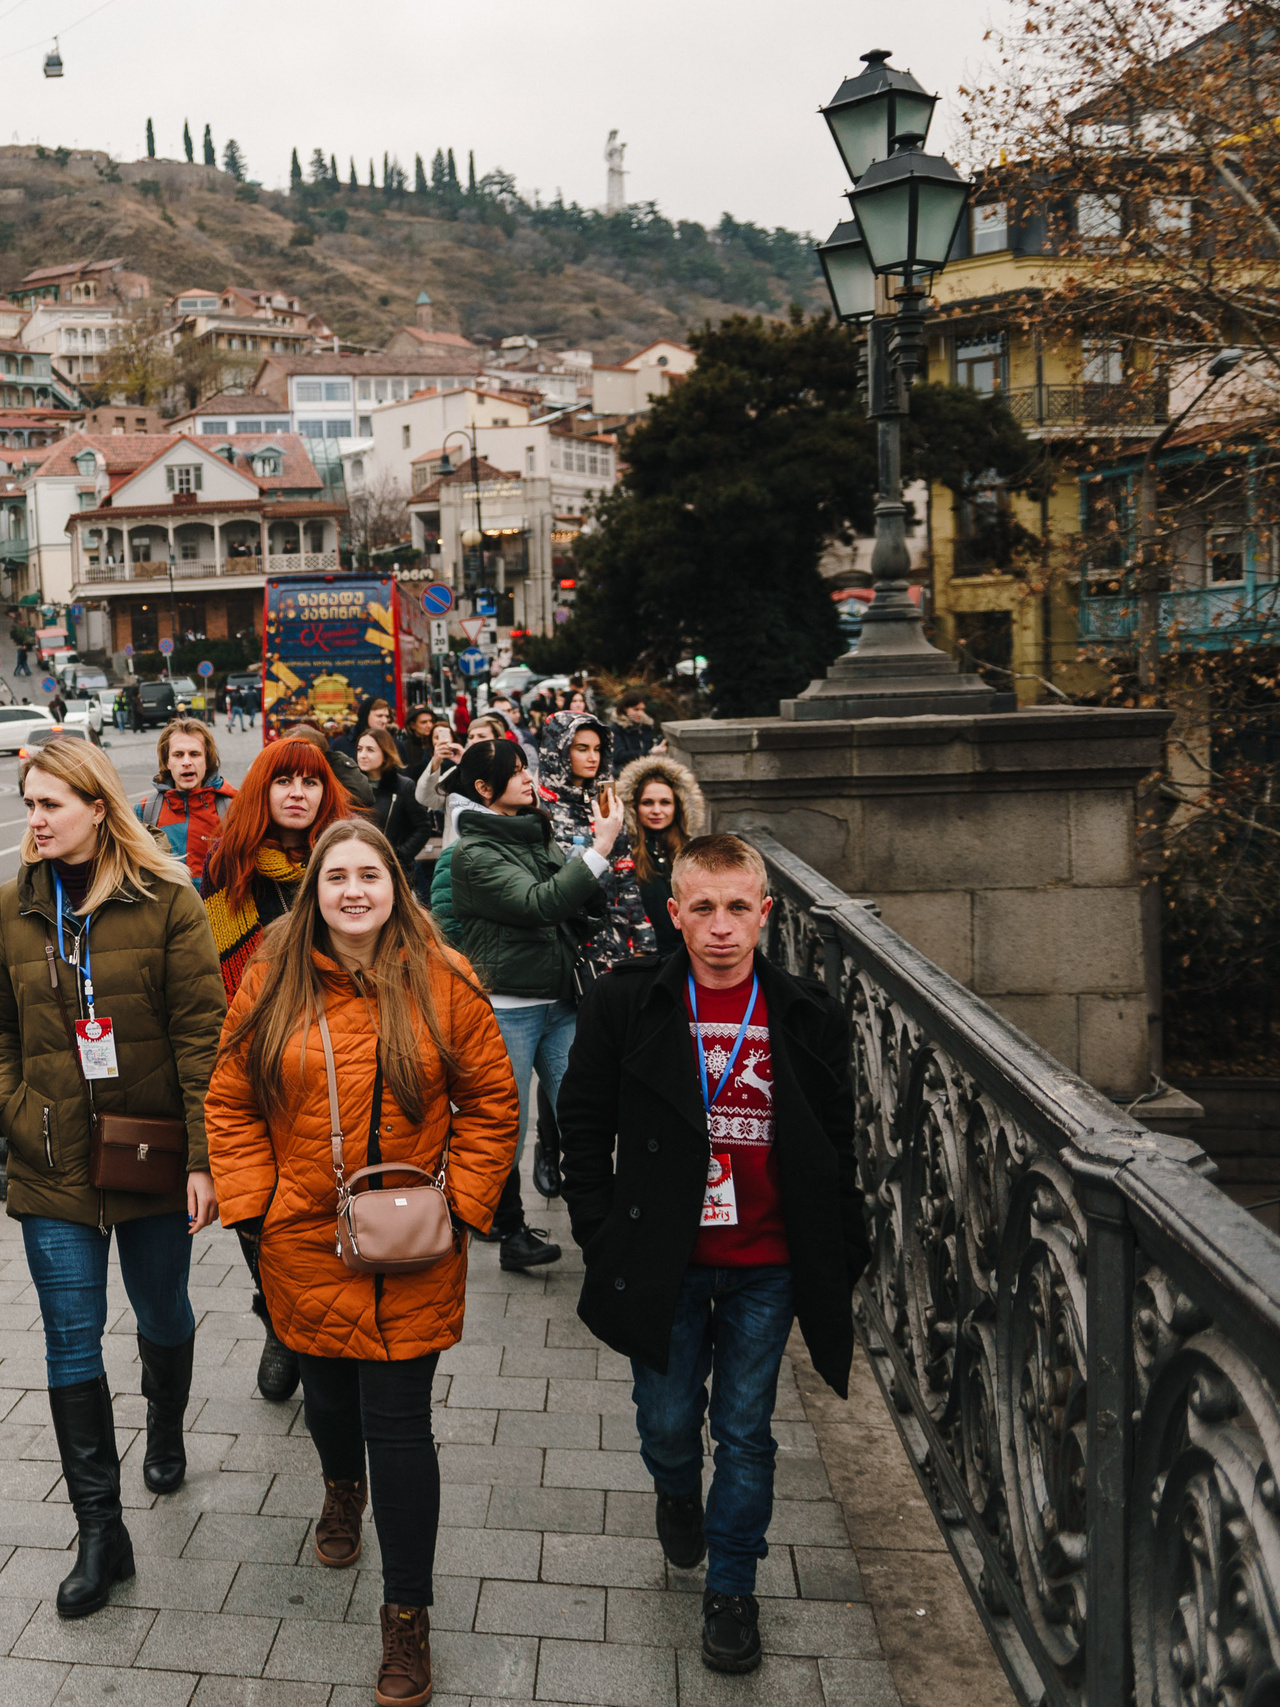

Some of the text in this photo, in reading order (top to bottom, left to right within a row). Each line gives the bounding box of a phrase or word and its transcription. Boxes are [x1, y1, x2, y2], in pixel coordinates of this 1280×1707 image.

[297, 591, 365, 607] ზანადუ
[300, 605, 362, 620] კაზინო
[434, 638, 446, 646] 20
